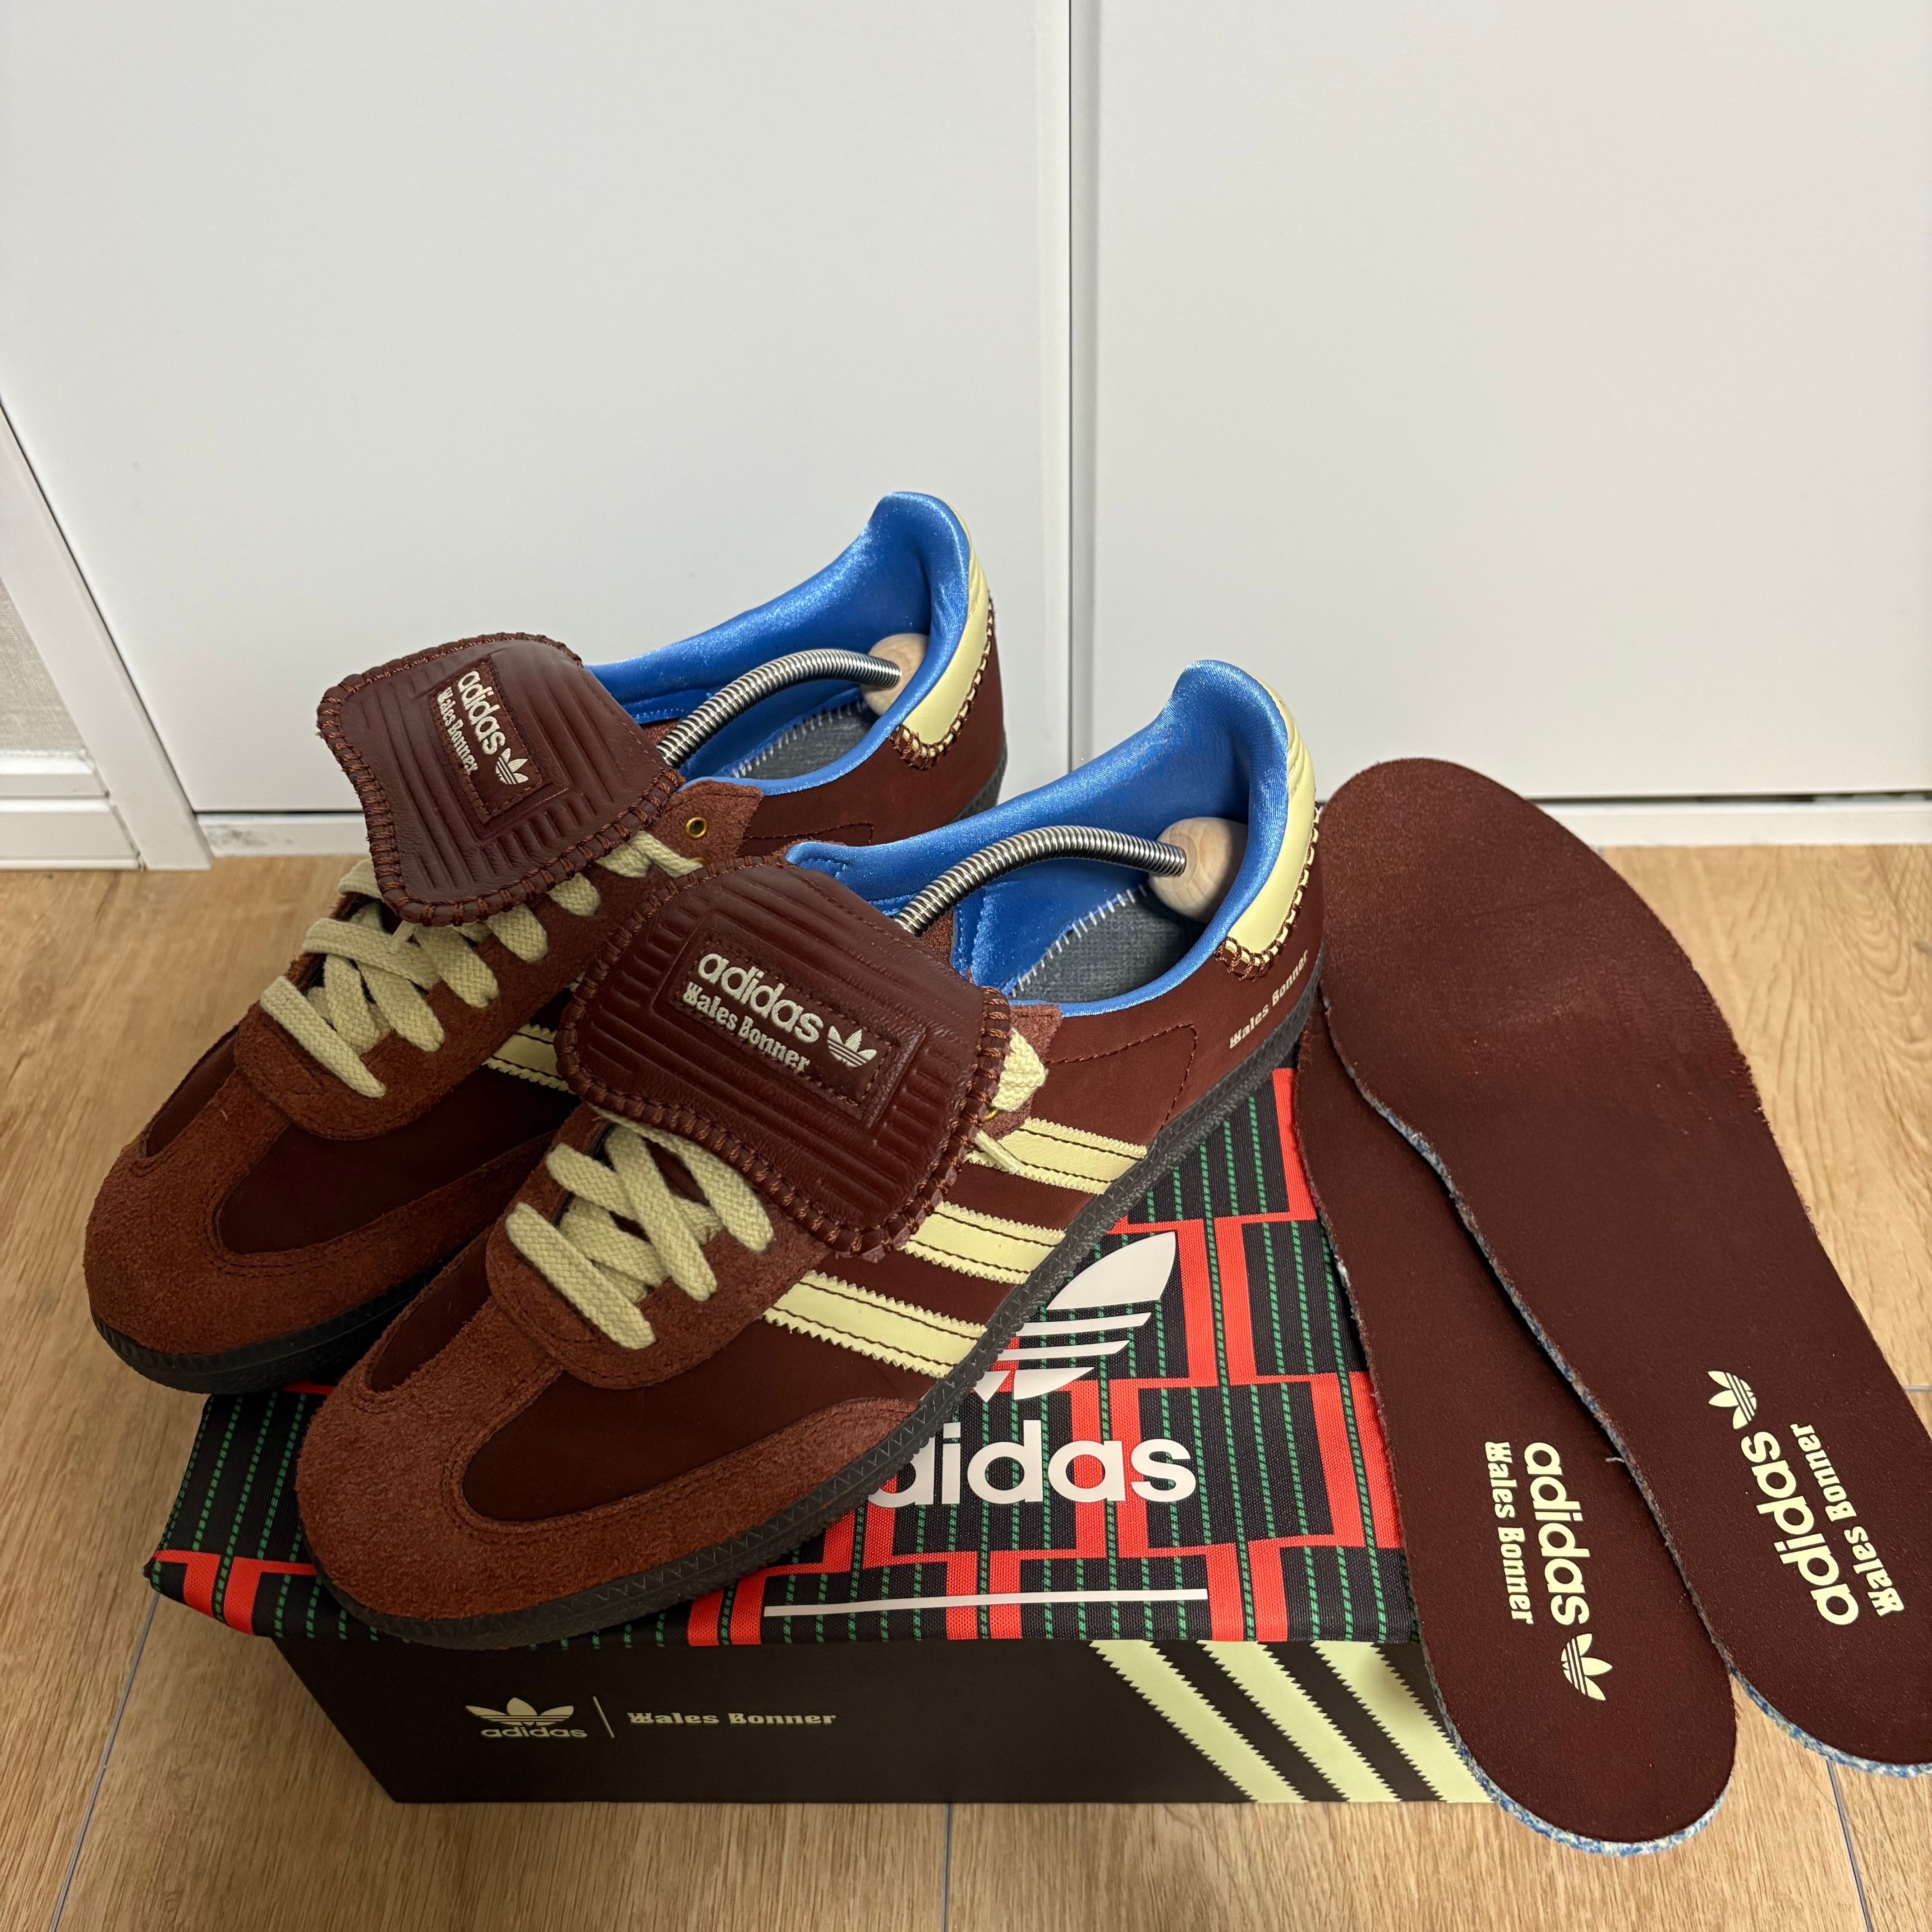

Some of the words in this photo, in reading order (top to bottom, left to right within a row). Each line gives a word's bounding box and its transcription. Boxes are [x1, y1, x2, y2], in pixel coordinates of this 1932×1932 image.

[437, 686, 456, 727] Wales
[448, 718, 479, 776] Bonner
[457, 671, 506, 755] adidas
[683, 981, 738, 1031] Wales
[738, 1015, 810, 1072] Bonner
[698, 953, 824, 1043] adidas
[1229, 1004, 1269, 1049] Wales
[1272, 949, 1307, 1007] Bonner
[868, 1419, 1196, 1508] didas
[1485, 1441, 1517, 1518] Wales
[1790, 1424, 1857, 1522] Bonner
[1524, 1442, 1591, 1625] adidas
[1741, 1431, 1859, 1625] adidas
[1844, 1526, 1904, 1616] Wales
[1498, 1527, 1534, 1624] Bonner
[481, 1726, 588, 1738] adidas
[627, 1712, 720, 1724] Wales
[727, 1712, 837, 1725] Bonner
